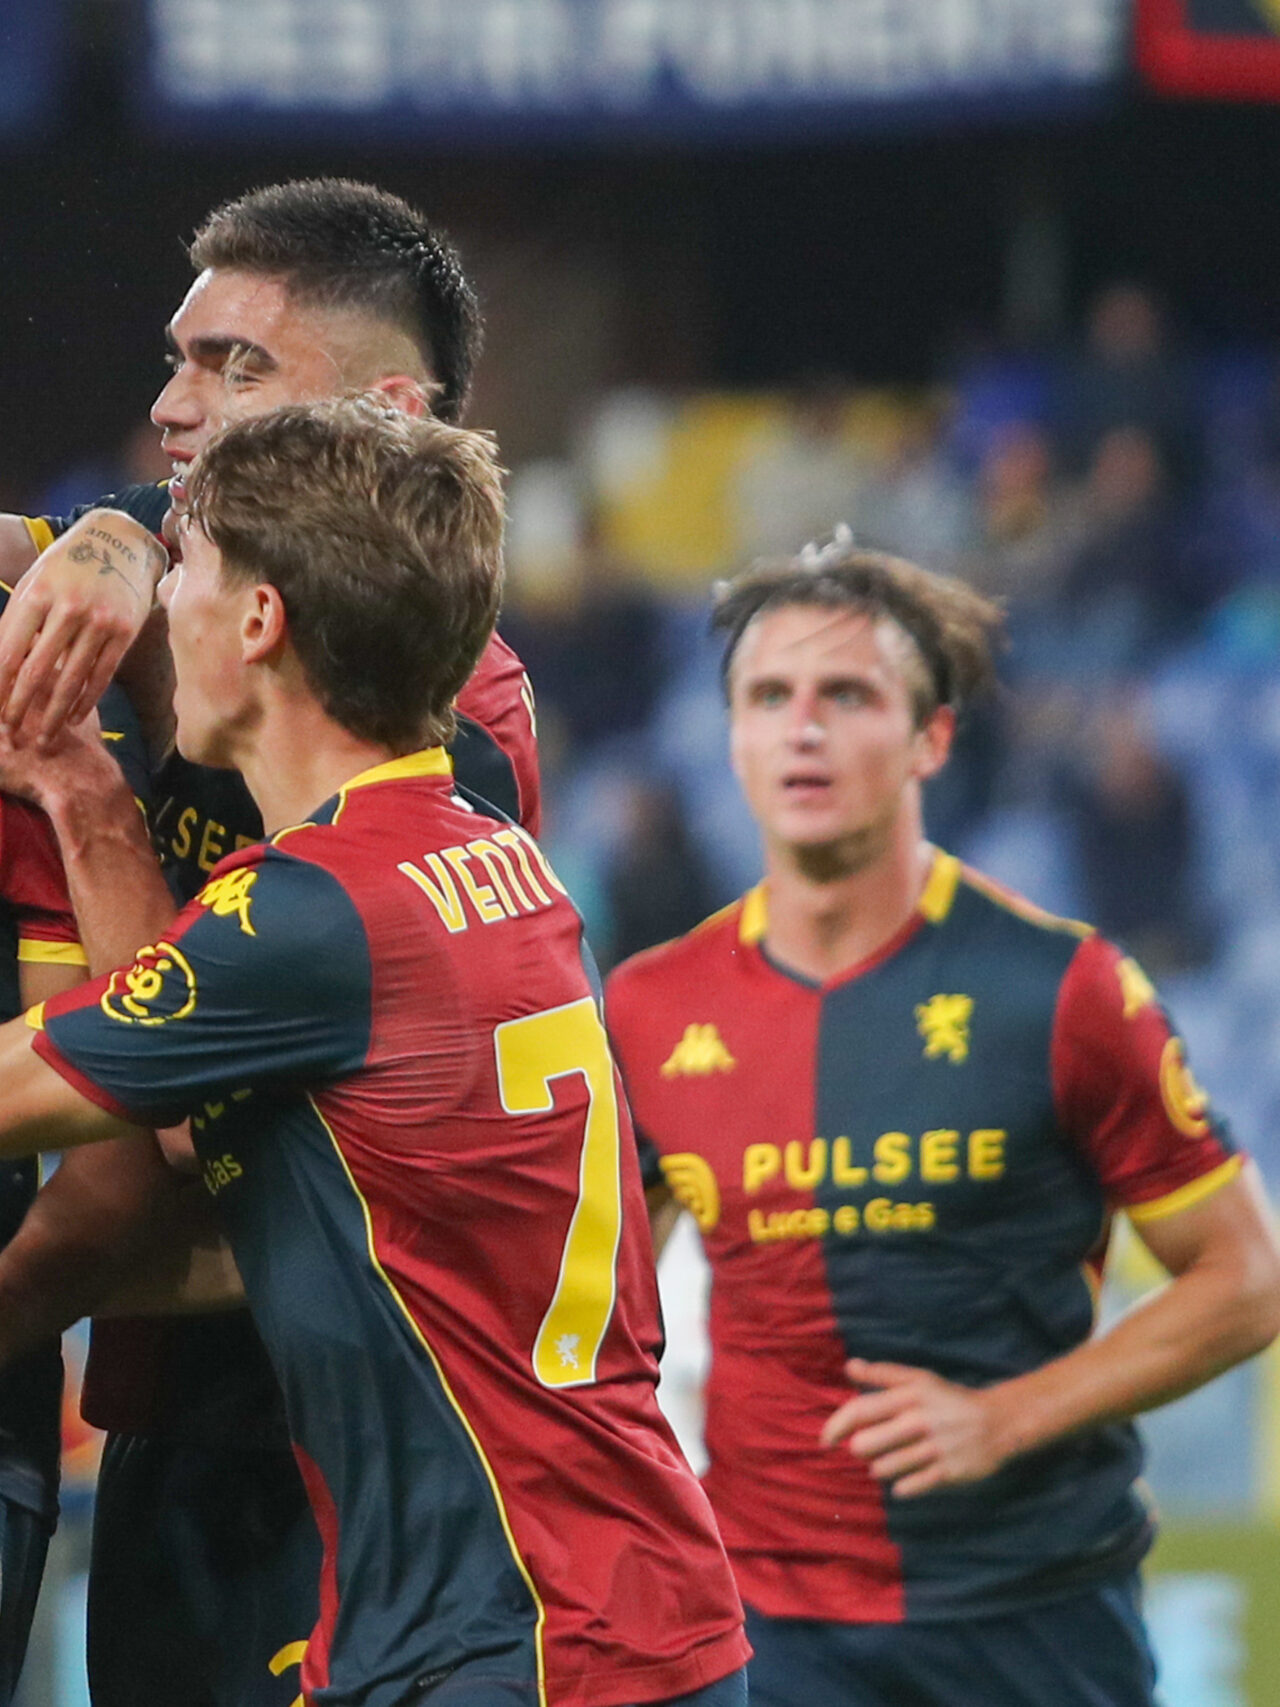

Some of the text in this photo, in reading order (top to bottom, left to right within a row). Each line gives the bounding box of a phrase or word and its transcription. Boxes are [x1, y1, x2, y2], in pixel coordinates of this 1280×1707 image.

[86, 527, 137, 562] amore
[742, 1128, 1008, 1197] PULSEE
[494, 996, 622, 1388] 7
[747, 1197, 937, 1243] Luce e Gas
